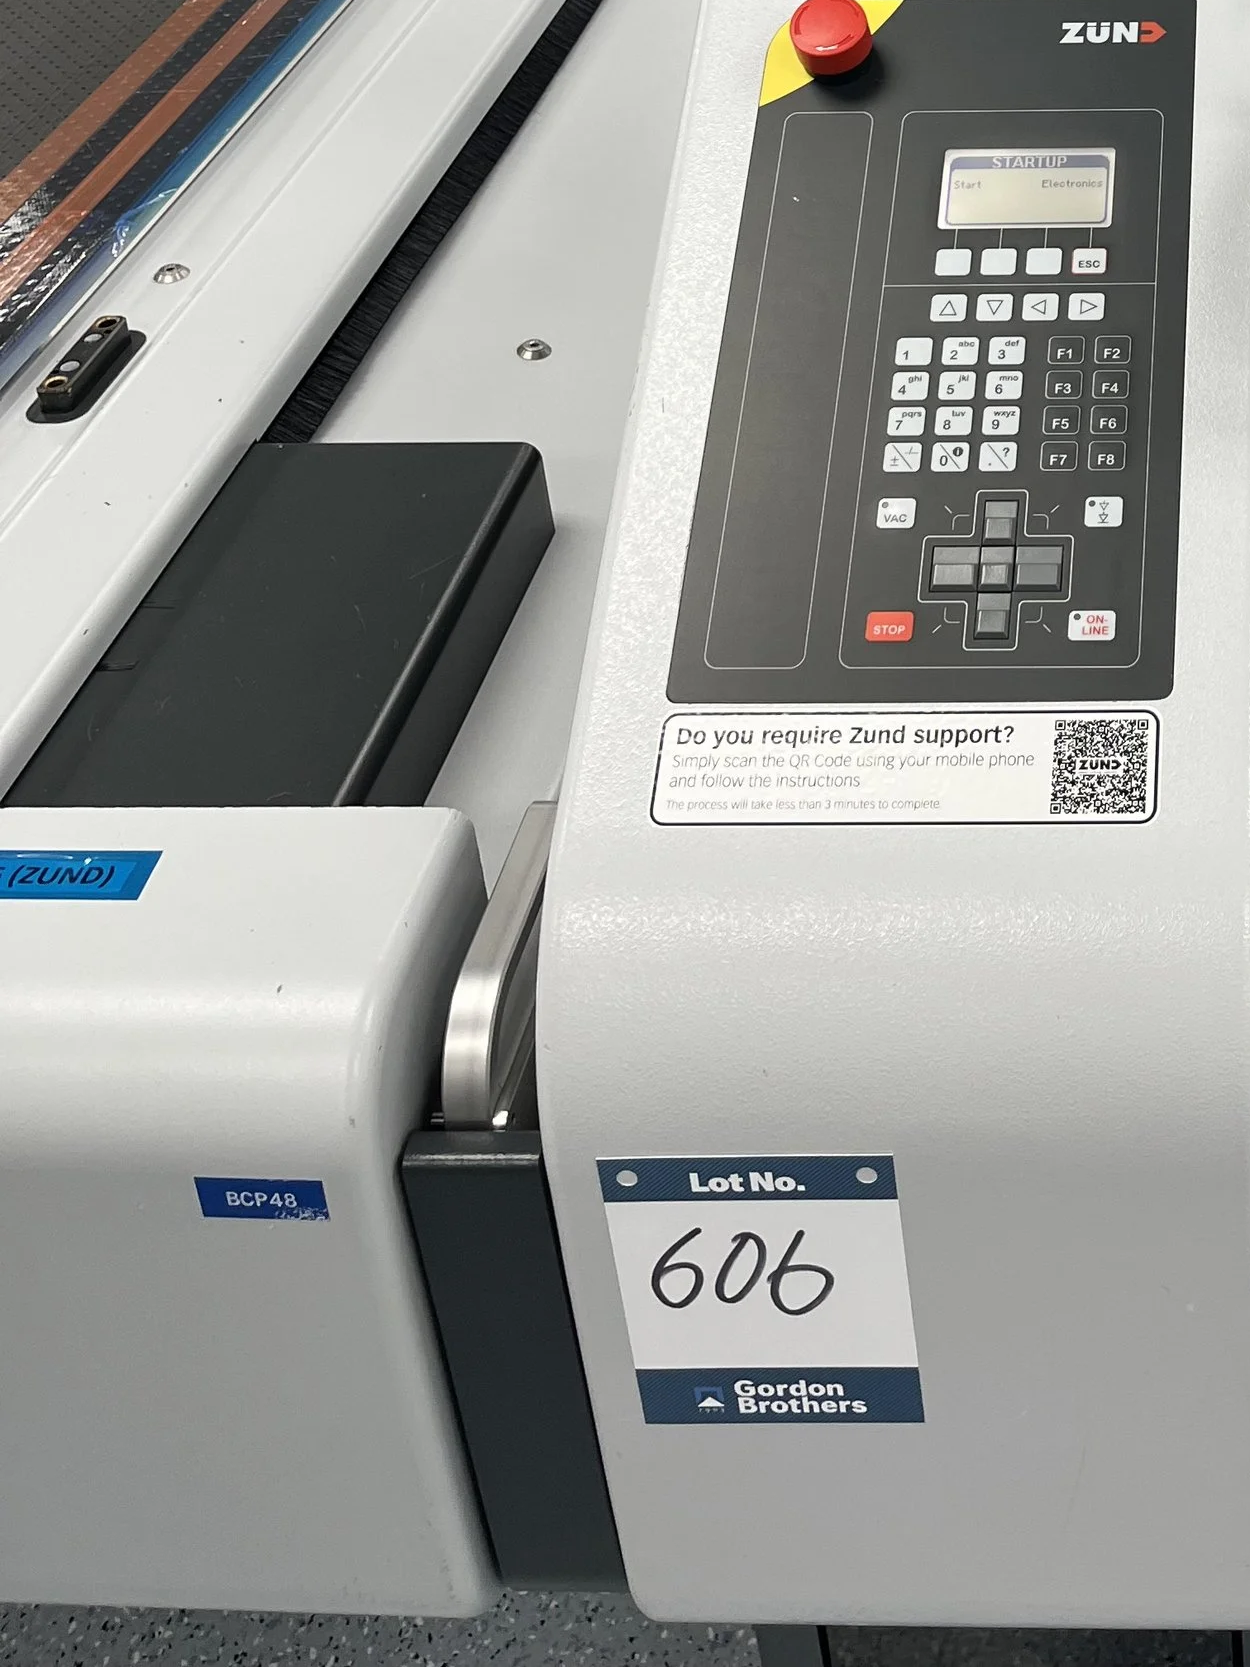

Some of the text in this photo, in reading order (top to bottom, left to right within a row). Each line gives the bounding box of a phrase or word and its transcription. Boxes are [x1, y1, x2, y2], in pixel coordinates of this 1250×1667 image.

[992, 155, 1068, 169] STARTUP
[954, 179, 1103, 190] Start Electronics
[1078, 260, 1101, 269] ESC
[958, 340, 975, 348] abc
[1005, 339, 1020, 347] def
[902, 350, 910, 360] 1
[950, 350, 958, 360] 2
[997, 349, 1006, 360] 3
[1056, 348, 1073, 359] F1
[1103, 348, 1121, 359] F2
[908, 374, 923, 383] ghi
[958, 373, 970, 383] jkl
[898, 384, 907, 395] 4
[946, 384, 955, 395] 5
[994, 384, 1003, 395] 6
[1054, 383, 1072, 394] F3
[1101, 383, 1119, 394] F4
[901, 410, 922, 419] pqrs
[993, 410, 1016, 418] wxyz
[895, 420, 903, 431] 7
[942, 419, 951, 430] 8
[991, 419, 1000, 430] 9
[1052, 418, 1070, 430] F5
[1099, 418, 1117, 429] F6
[1002, 447, 1011, 458] ?
[939, 455, 948, 467] 0
[1049, 454, 1068, 466] F7
[1097, 454, 1115, 466] F8
[884, 513, 907, 523] VAC
[1086, 615, 1108, 624] ON-
[873, 624, 905, 635] STOP
[1082, 626, 1108, 635] LINE
[677, 725, 1015, 749] Do you require Zund support?
[672, 751, 1035, 770] Simply scan the QR Code using your mobile phone
[669, 773, 860, 788] and follow the instructions
[666, 798, 940, 812] The process will take less than 3 minutes to complete
[7, 864, 115, 888] (ZUND)
[689, 1171, 807, 1193] Lot No.
[225, 1191, 297, 1208] BCP48
[651, 1227, 835, 1316] 606
[733, 1380, 845, 1397] Gordon
[737, 1397, 868, 1414] Brothers
